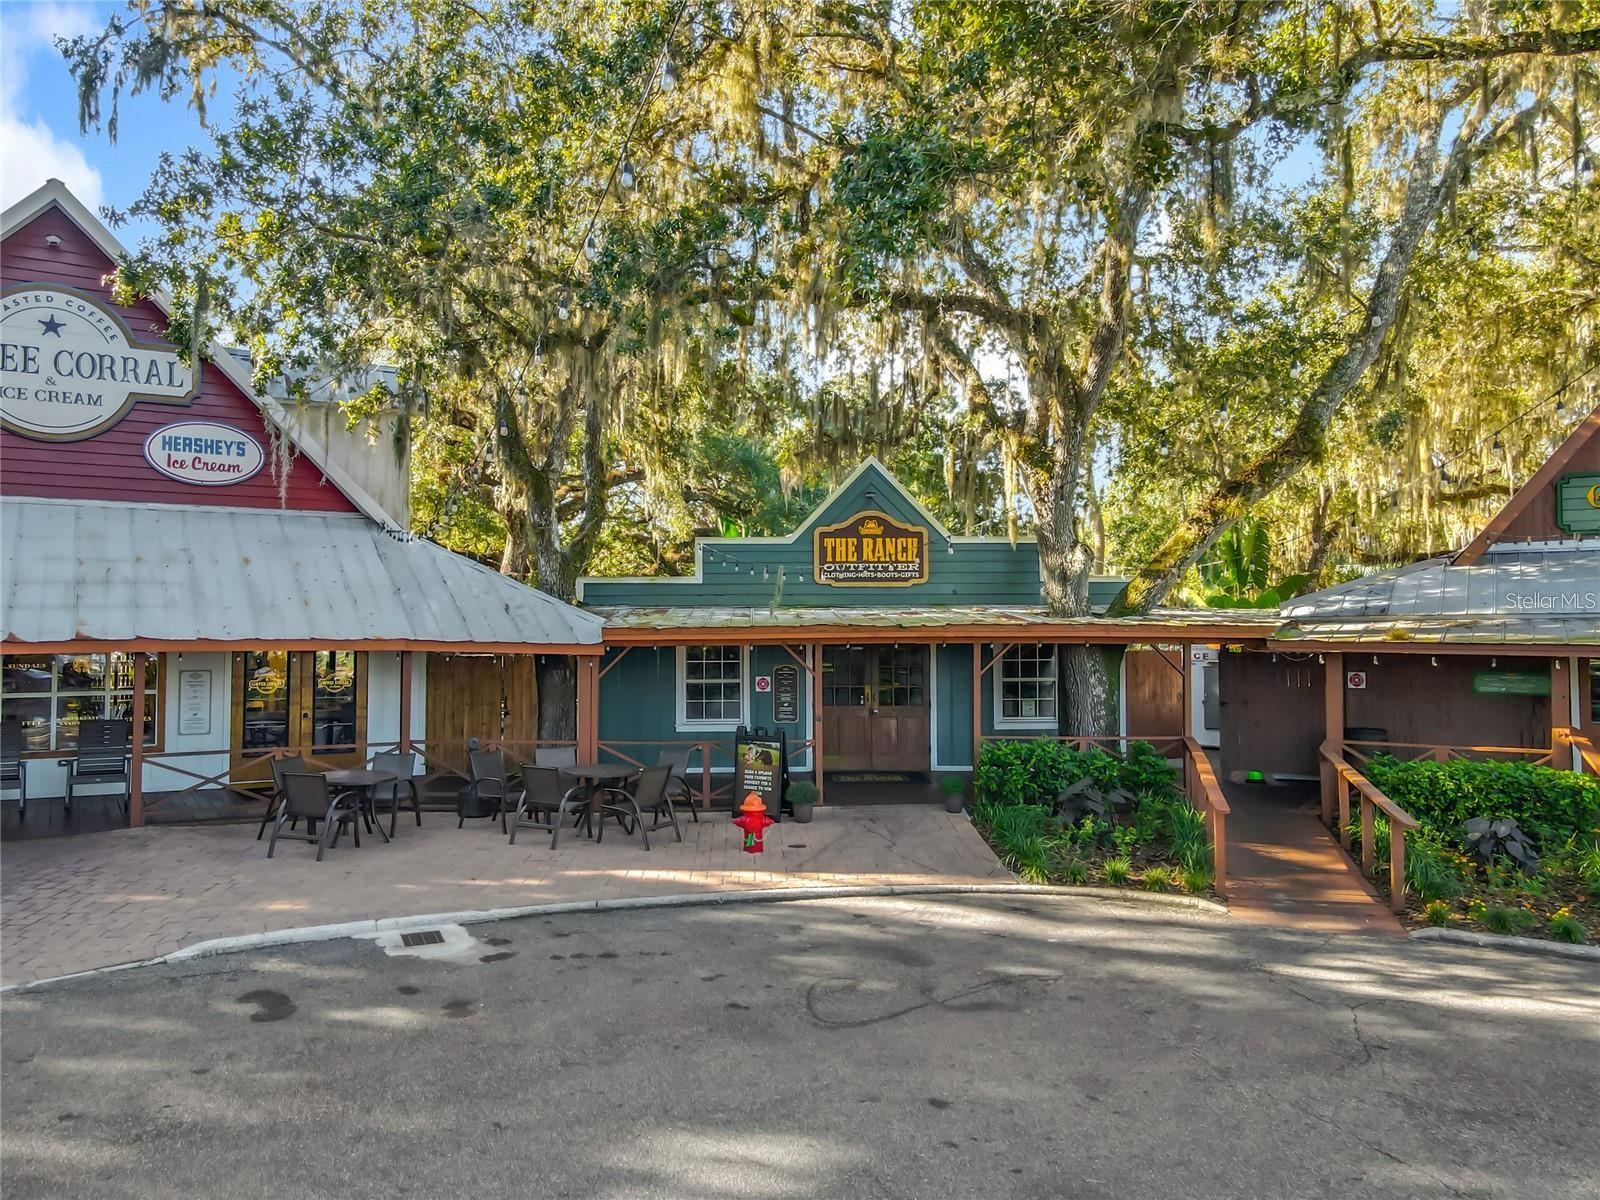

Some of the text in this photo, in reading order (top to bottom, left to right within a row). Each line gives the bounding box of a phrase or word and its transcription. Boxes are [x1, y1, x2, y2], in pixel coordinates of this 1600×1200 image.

[66, 300, 119, 342] COFFEE
[53, 349, 185, 388] CORRAL
[45, 375, 57, 386] &
[34, 389, 104, 407] CREAM
[161, 434, 246, 458] HERSHEY'S
[166, 453, 243, 473] Ice Cream
[823, 537, 919, 562] THE RANCH
[823, 563, 920, 571] OUTFITTER
